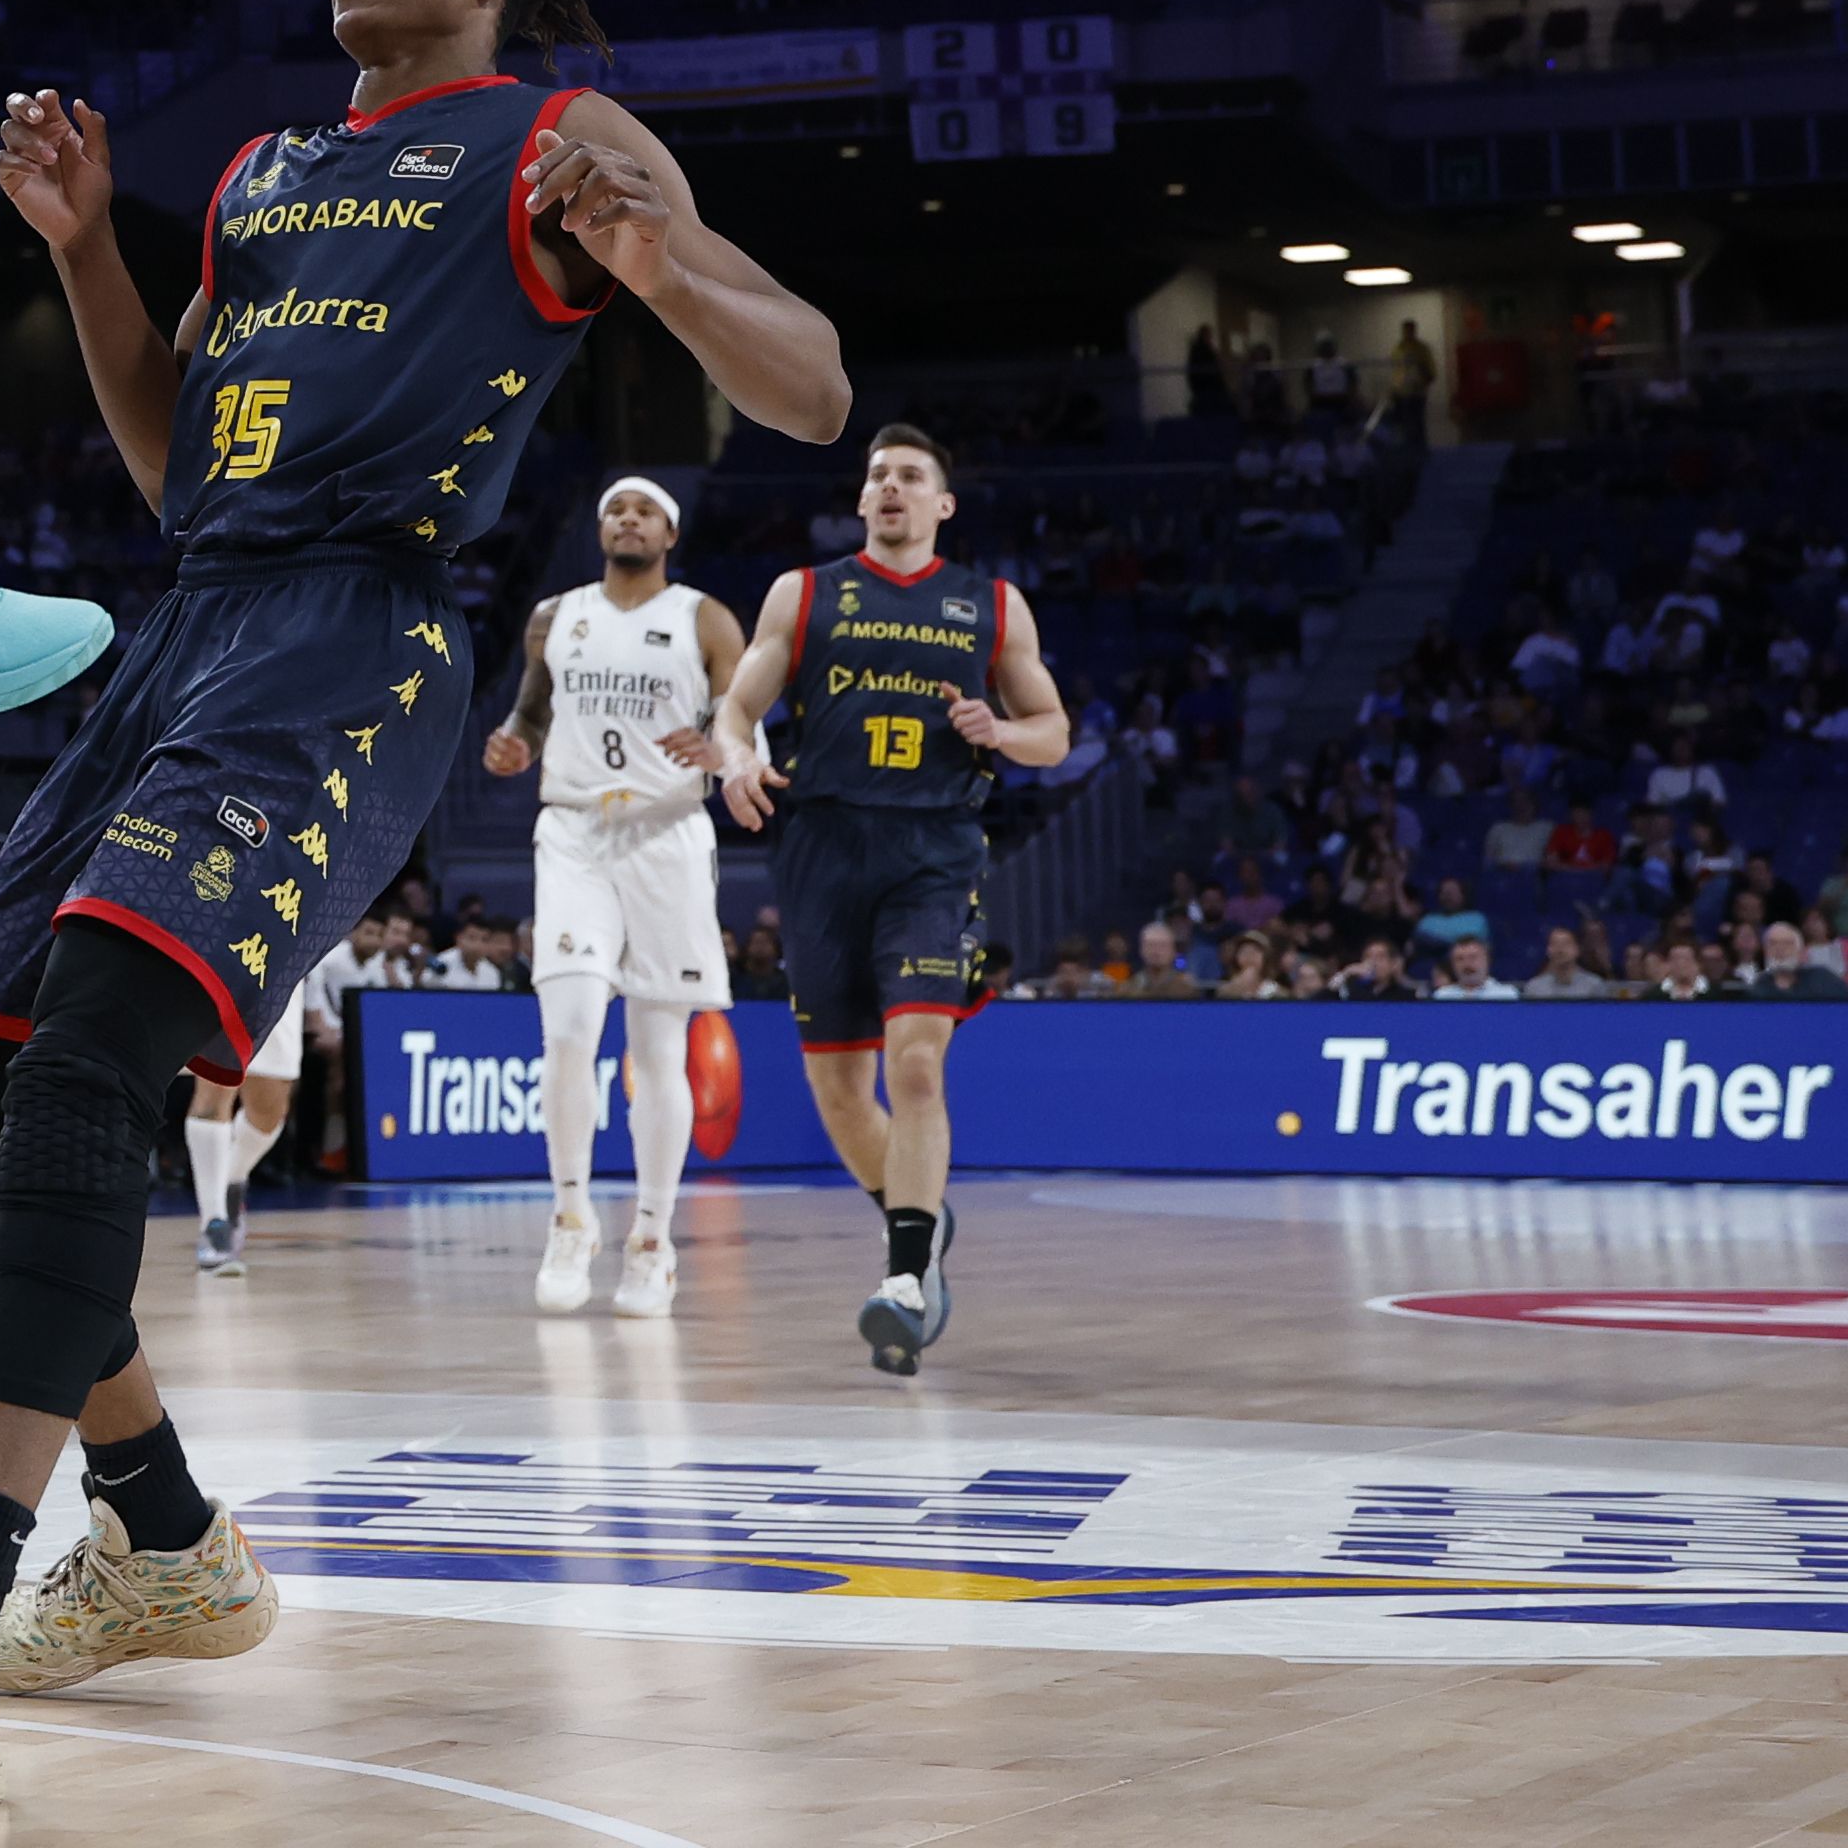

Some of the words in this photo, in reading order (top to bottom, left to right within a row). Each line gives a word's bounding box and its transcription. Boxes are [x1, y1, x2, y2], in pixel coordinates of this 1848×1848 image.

[935, 29, 966, 70] 2
[1047, 23, 1078, 64] 0
[937, 109, 969, 152] 0
[1055, 103, 1086, 147] 9
[397, 162, 450, 174] endesa
[401, 153, 426, 165] liga
[240, 198, 443, 241] MORABANC
[232, 287, 389, 342] Andorra
[204, 379, 292, 484] 35
[851, 621, 977, 653] MORABANC
[564, 666, 674, 700] Emirates
[856, 666, 964, 700] Andor
[603, 728, 626, 770] 8
[863, 714, 924, 771] 13
[224, 809, 257, 837] acb
[400, 1030, 620, 1136] Transar
[1320, 1037, 1835, 1142] Transaher
